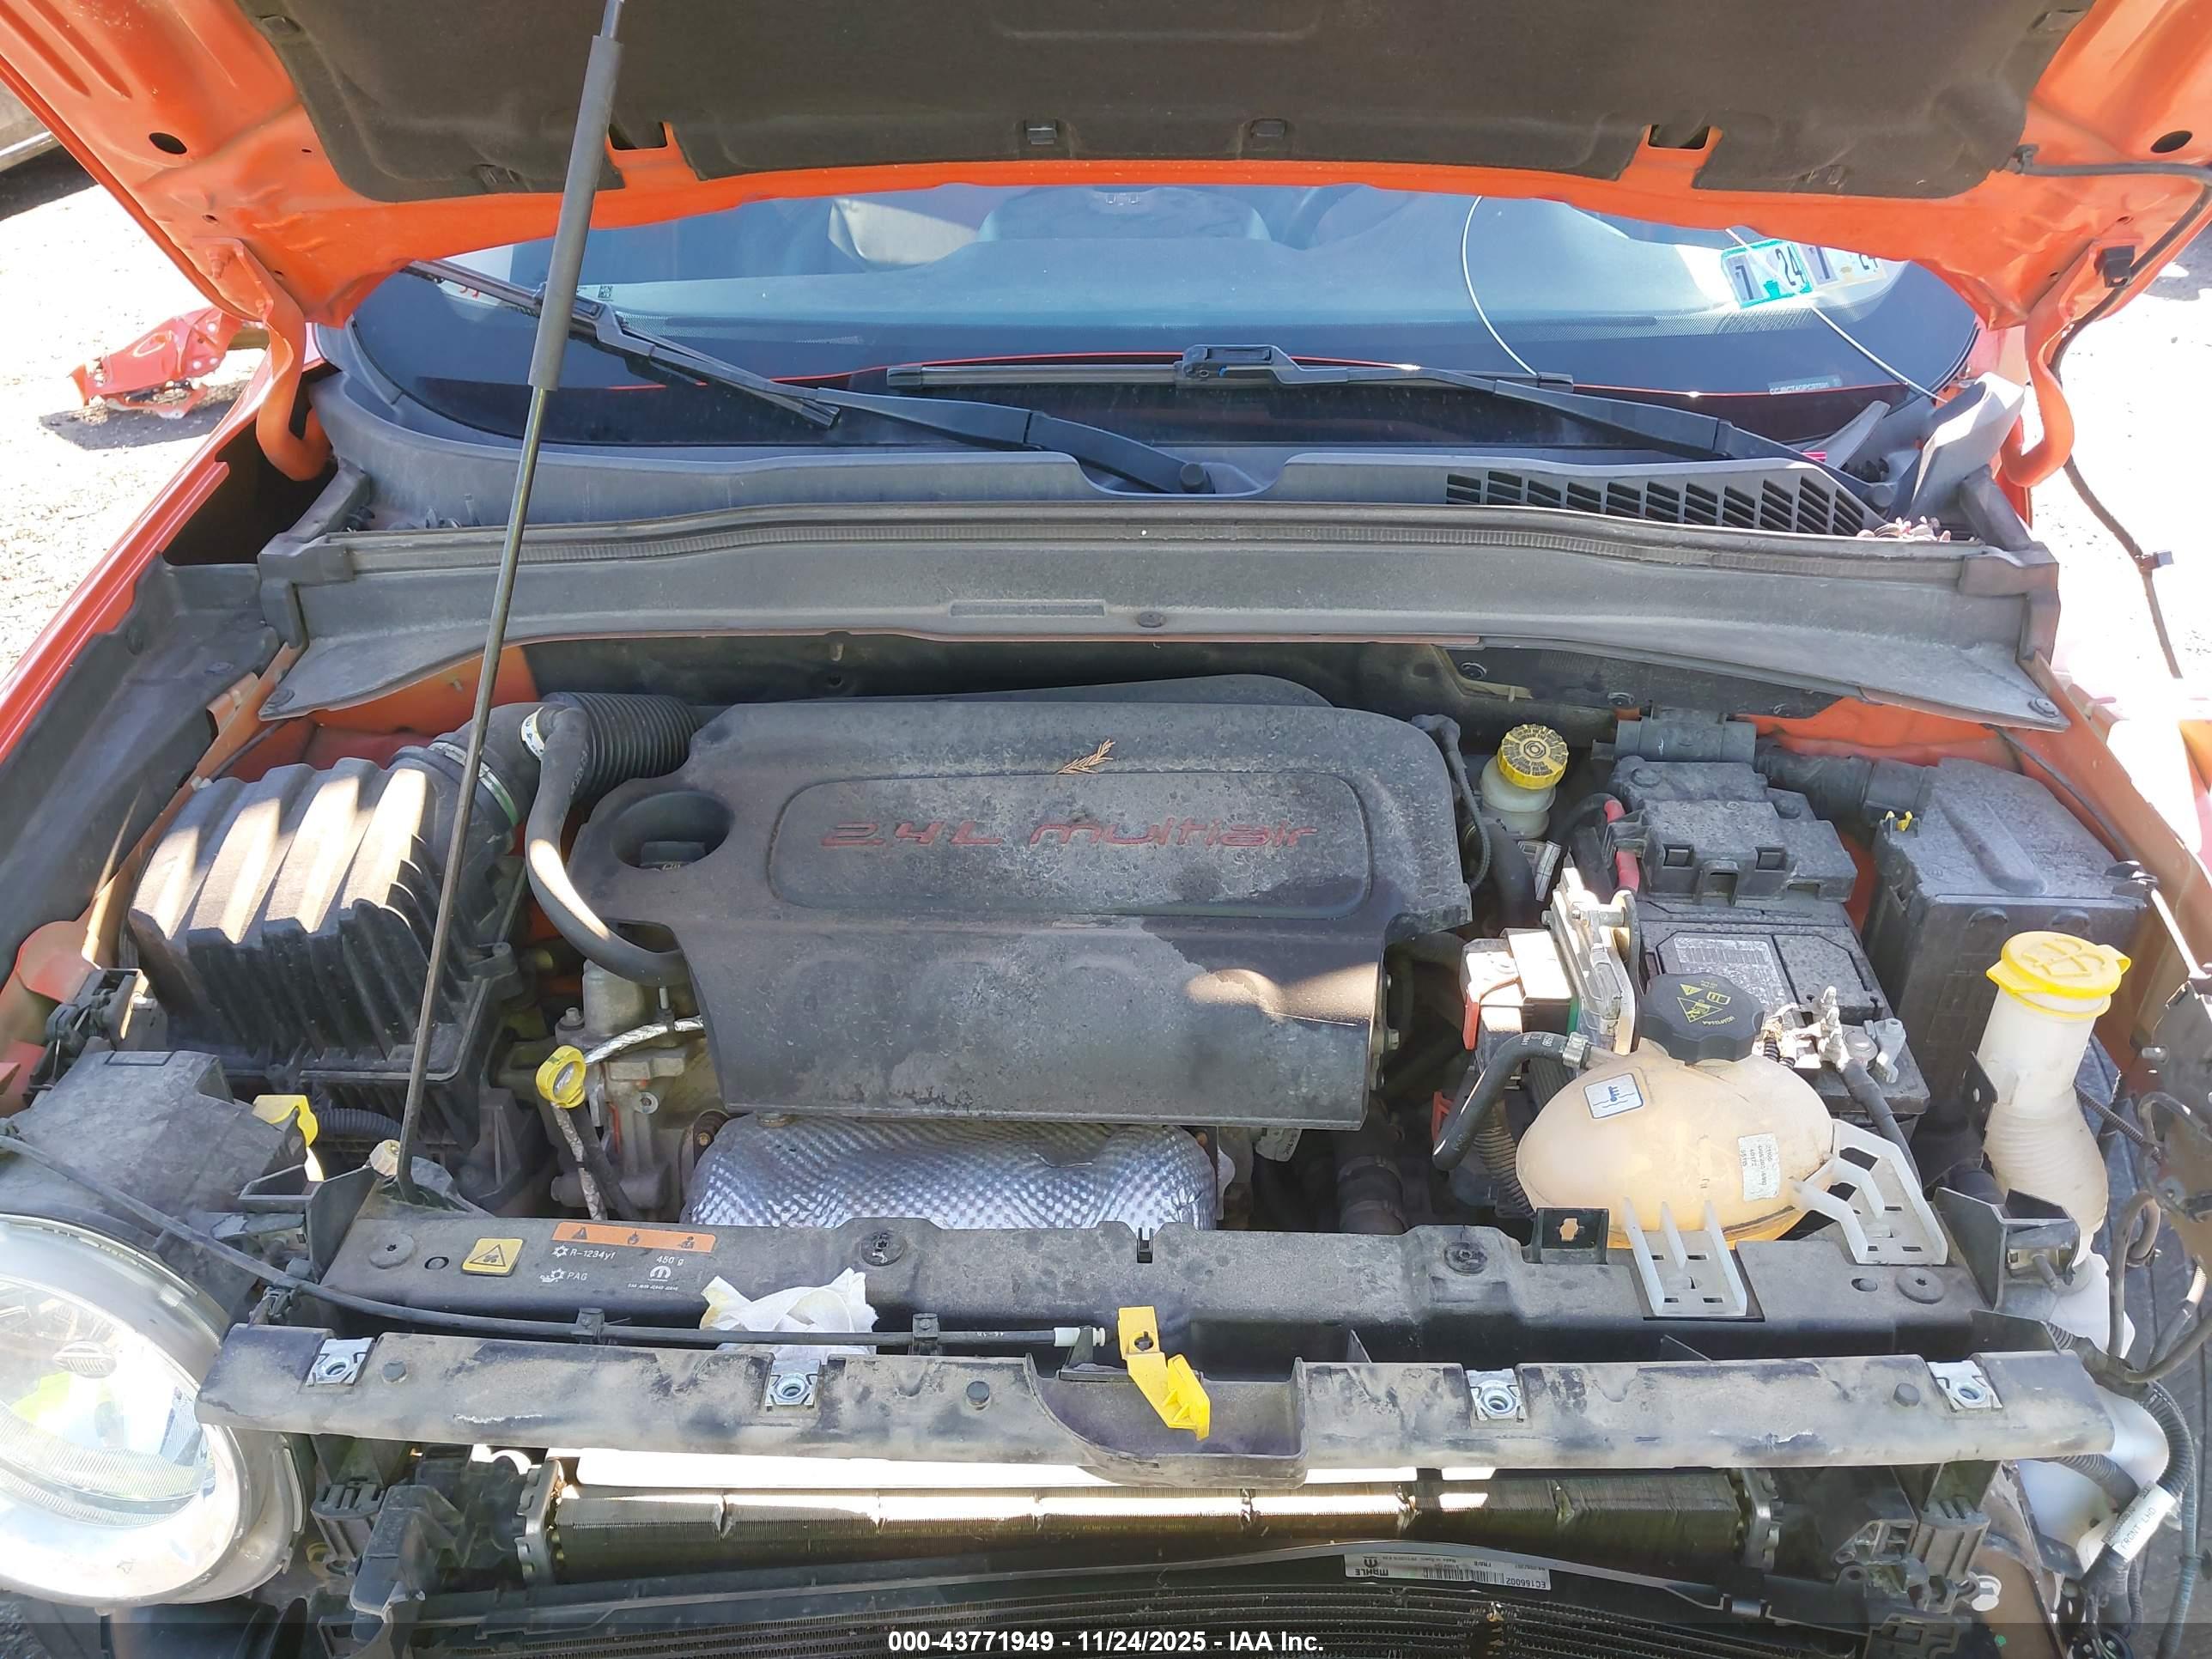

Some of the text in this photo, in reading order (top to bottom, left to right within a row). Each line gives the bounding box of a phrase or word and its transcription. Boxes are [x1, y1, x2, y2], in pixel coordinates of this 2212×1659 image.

[1774, 246, 1807, 286] 24
[821, 817, 1317, 847] 2.4L multiair
[569, 1248, 617, 1261] R-1234yf
[656, 1255, 675, 1264] 450
[567, 1272, 588, 1280] PAG
[1354, 1568, 1389, 1577] MAHLE
[1506, 1577, 1546, 1589] EC166002
